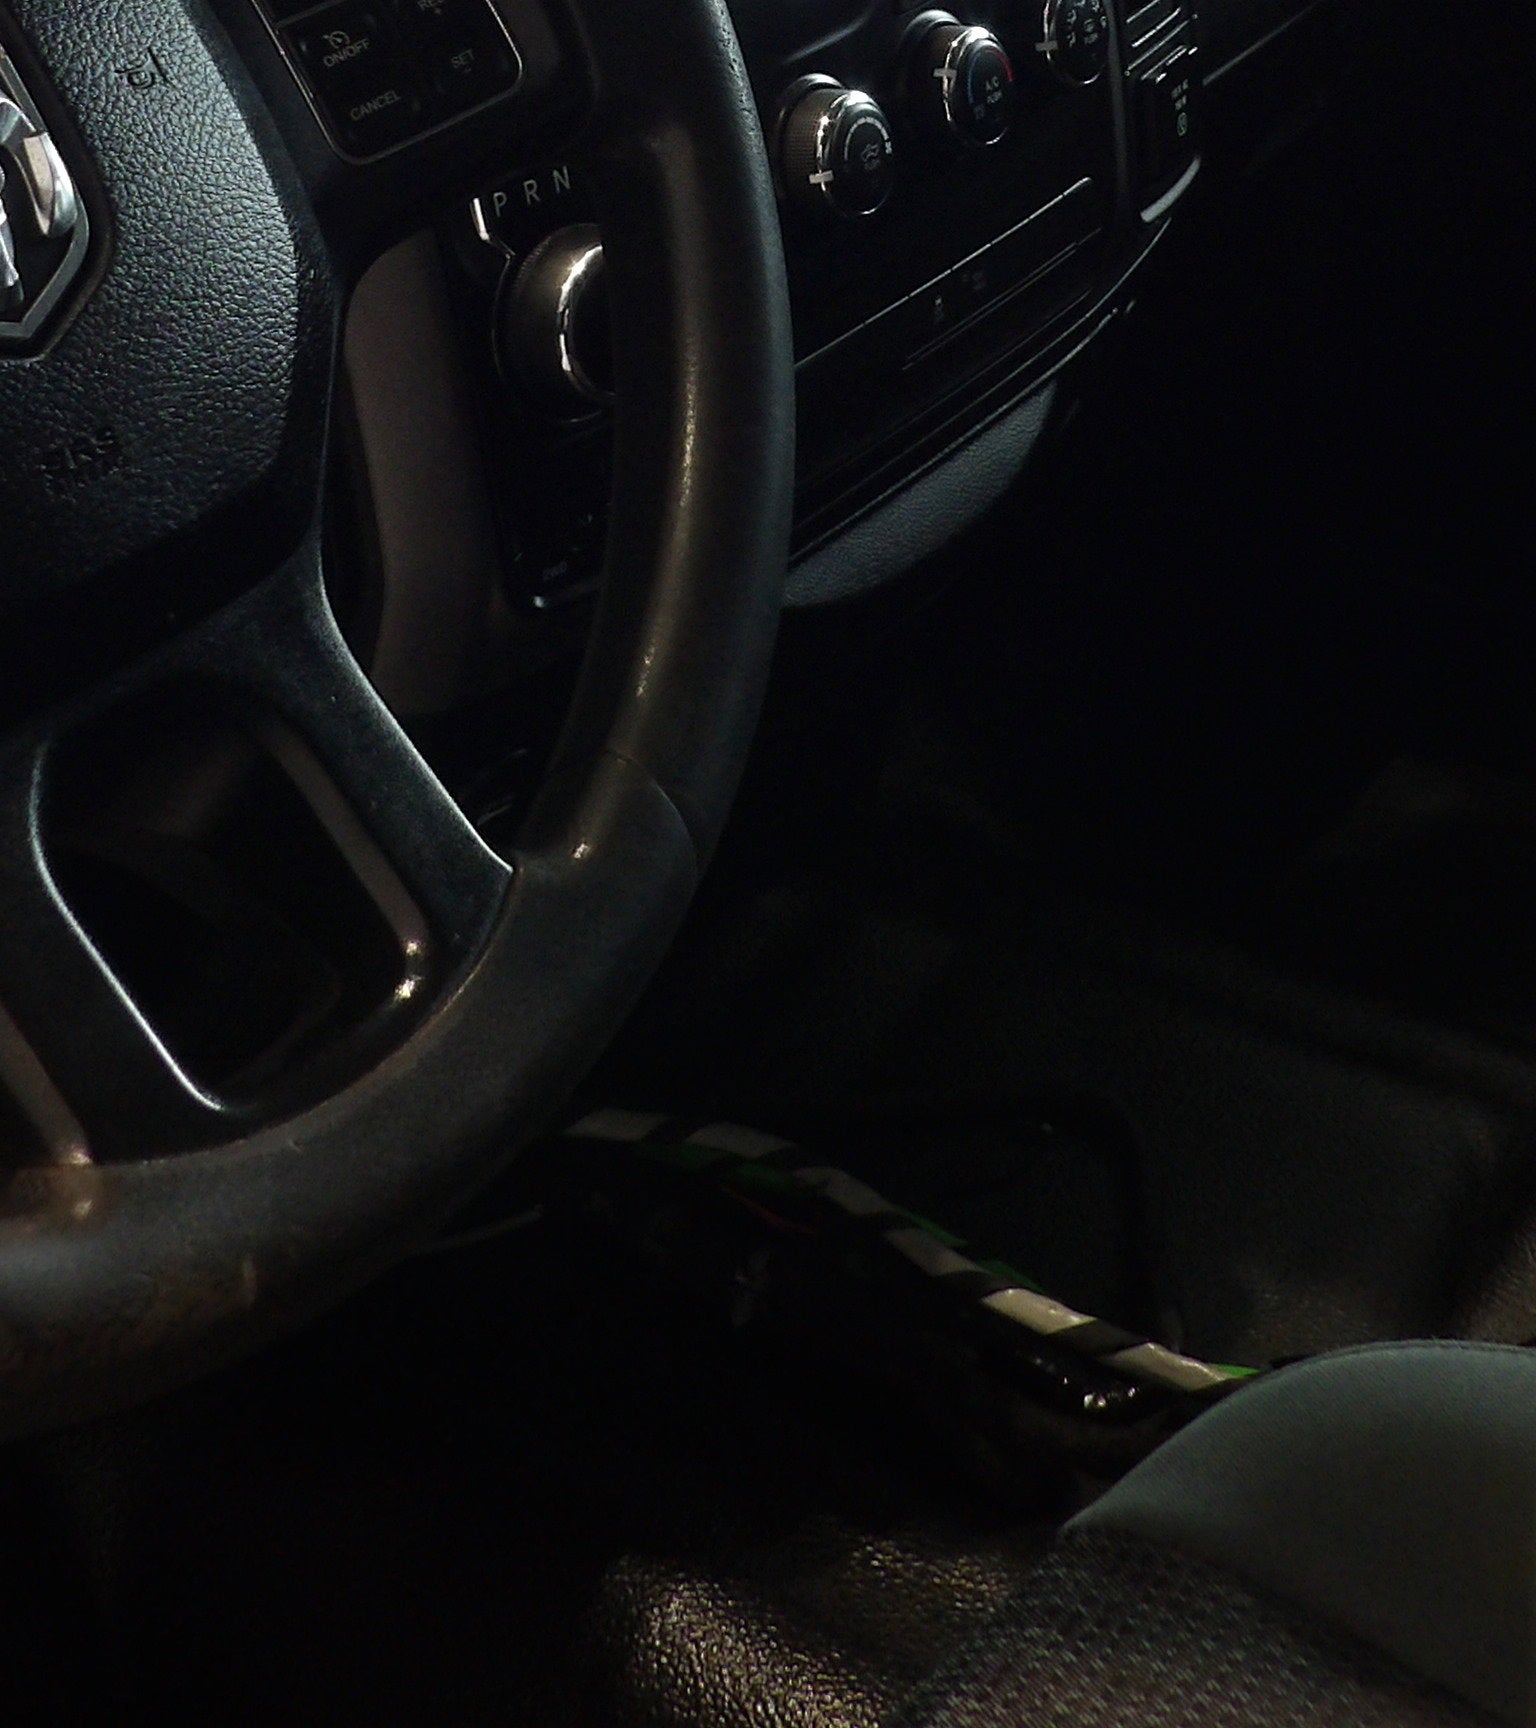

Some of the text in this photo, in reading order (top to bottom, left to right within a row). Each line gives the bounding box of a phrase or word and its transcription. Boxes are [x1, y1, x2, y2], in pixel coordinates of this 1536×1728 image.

[322, 37, 371, 68] ON/OFF
[450, 48, 476, 69] SET
[349, 90, 401, 121] CANCEL
[492, 166, 572, 217] P R N
